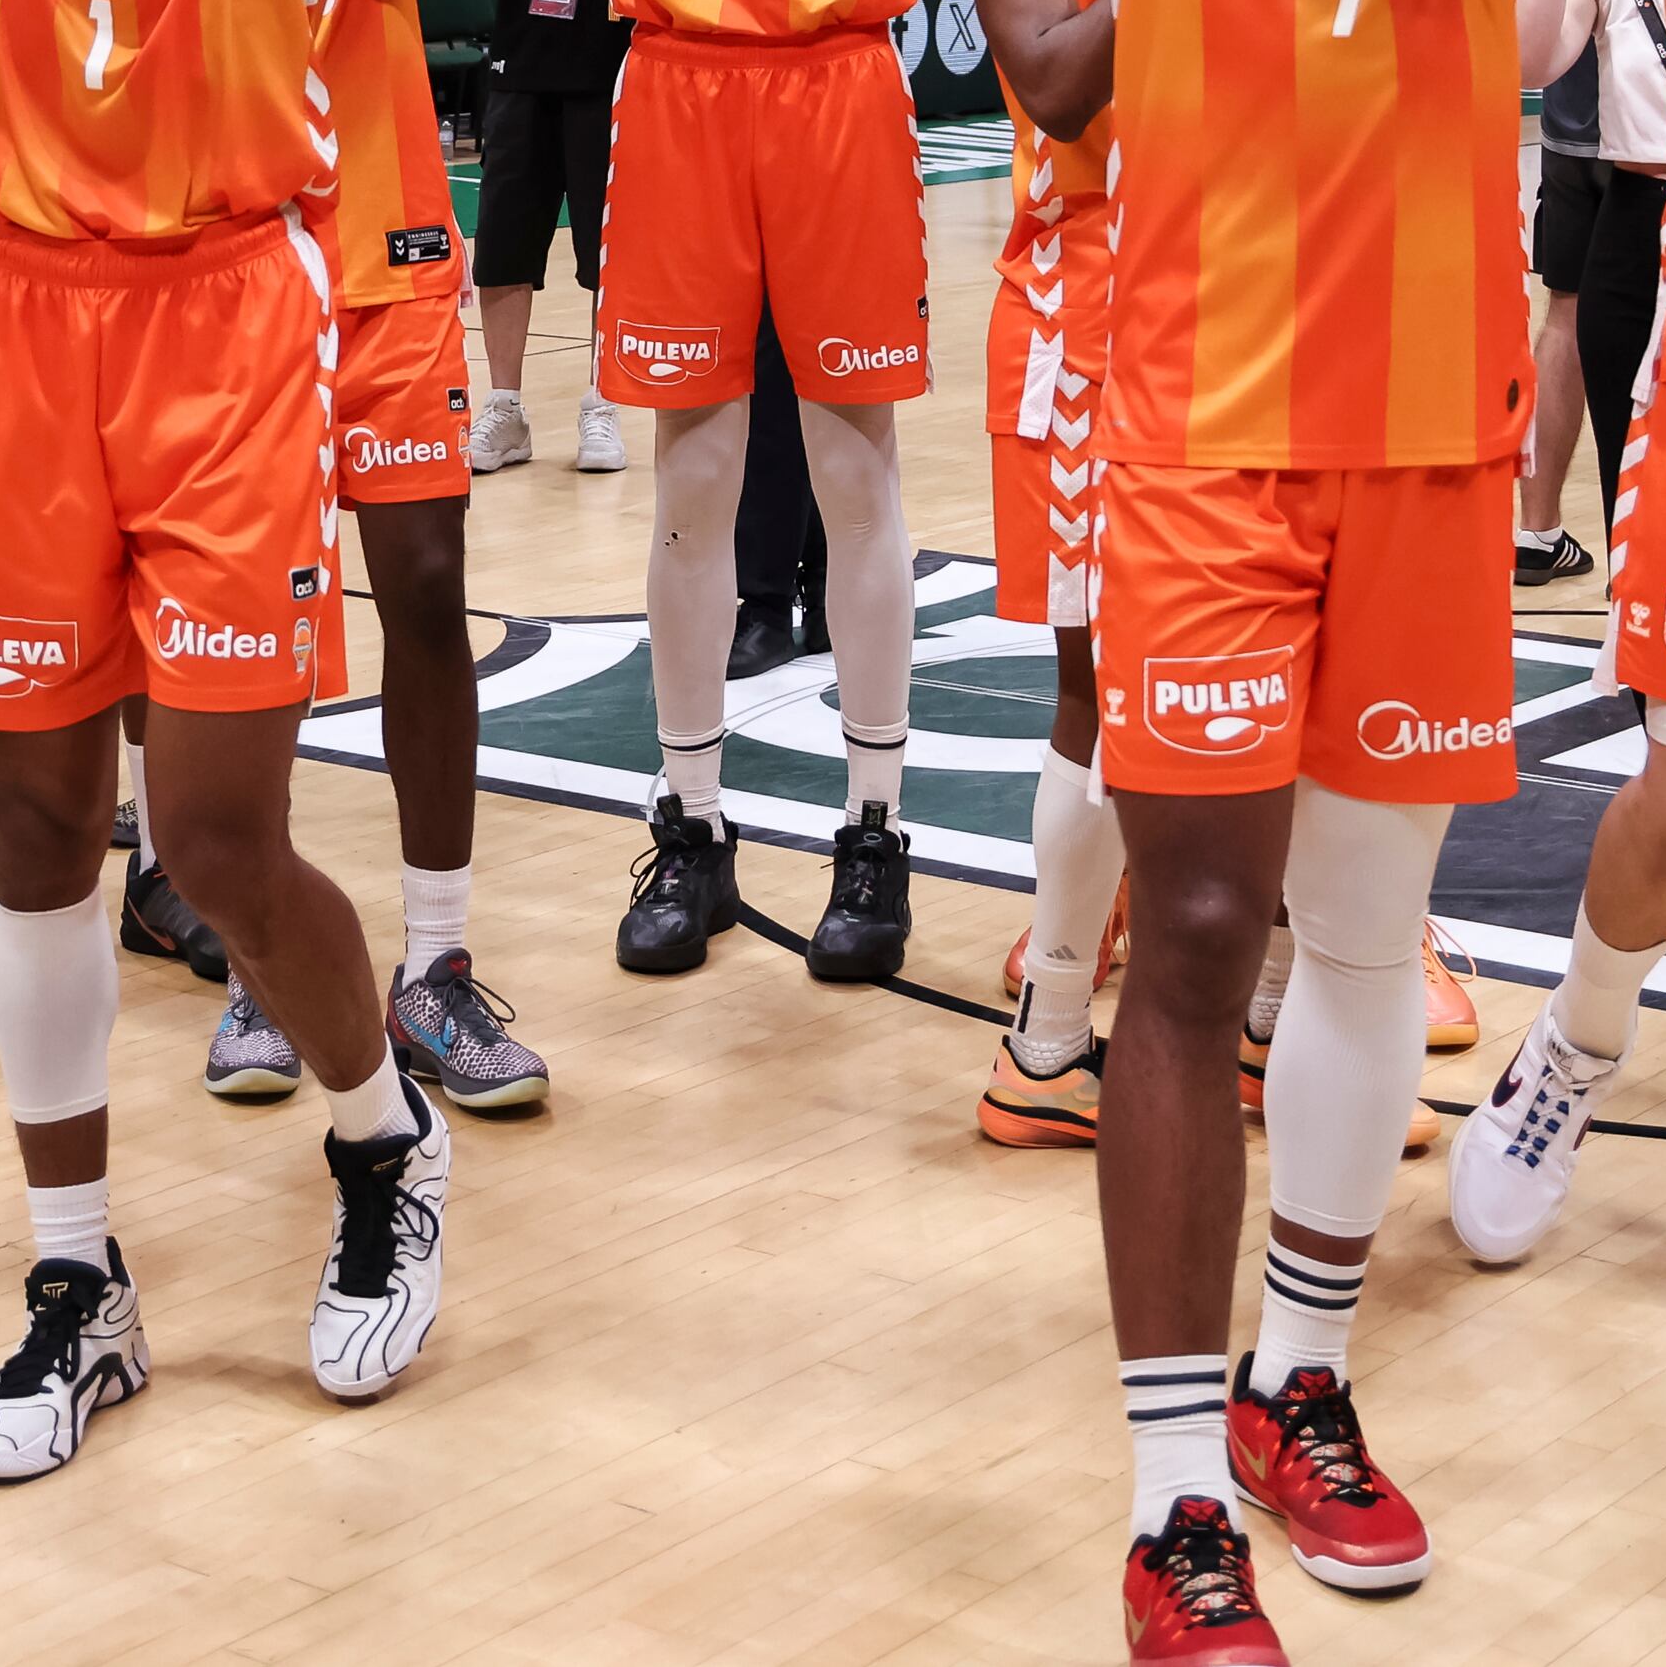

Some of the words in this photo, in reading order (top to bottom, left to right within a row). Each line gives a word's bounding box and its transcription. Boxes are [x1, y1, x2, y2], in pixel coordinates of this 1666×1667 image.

[622, 337, 711, 362] PULEVA
[838, 342, 920, 370] Midea
[359, 433, 447, 469] Midea
[165, 614, 277, 659] Midea
[1156, 673, 1287, 715] PULEVA
[1383, 717, 1511, 754] Midea
